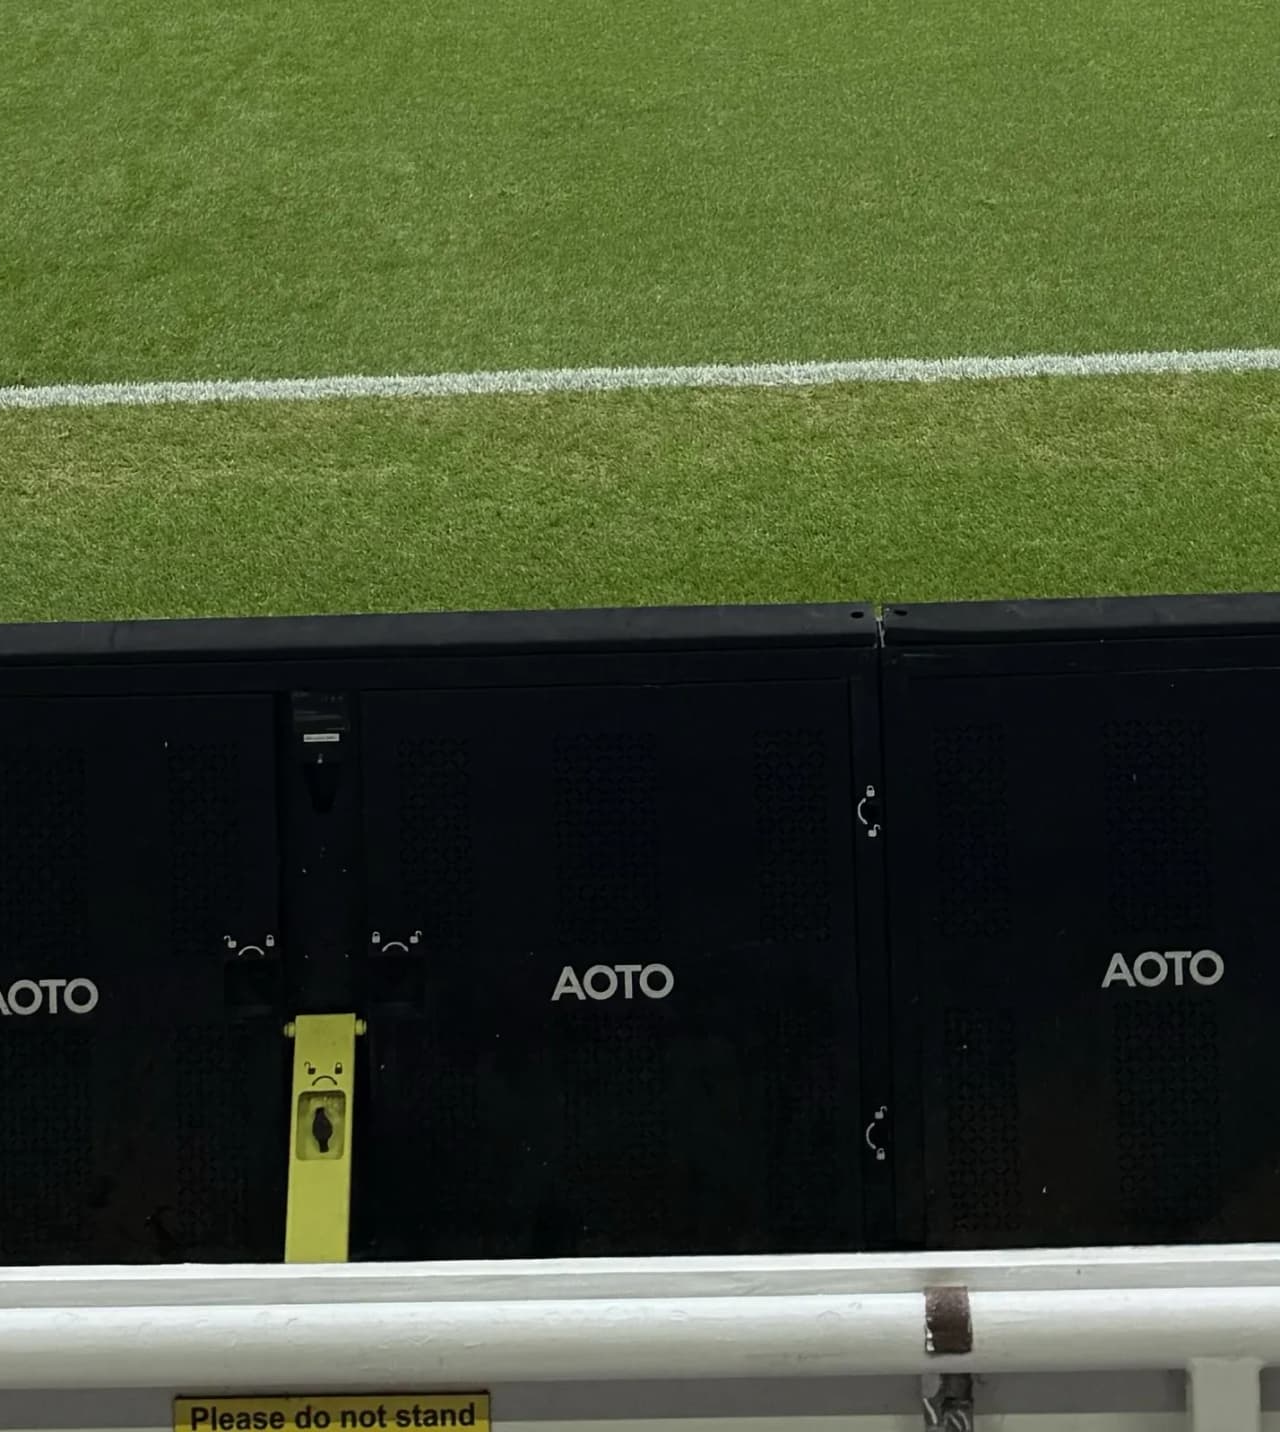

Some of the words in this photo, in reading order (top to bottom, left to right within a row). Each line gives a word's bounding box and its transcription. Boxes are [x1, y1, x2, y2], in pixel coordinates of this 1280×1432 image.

[552, 964, 674, 1001] AOTO
[1102, 950, 1225, 988] AOTO
[191, 1406, 285, 1431] Please
[295, 1405, 331, 1429] do
[341, 1404, 387, 1428] not
[396, 1402, 475, 1427] stand
